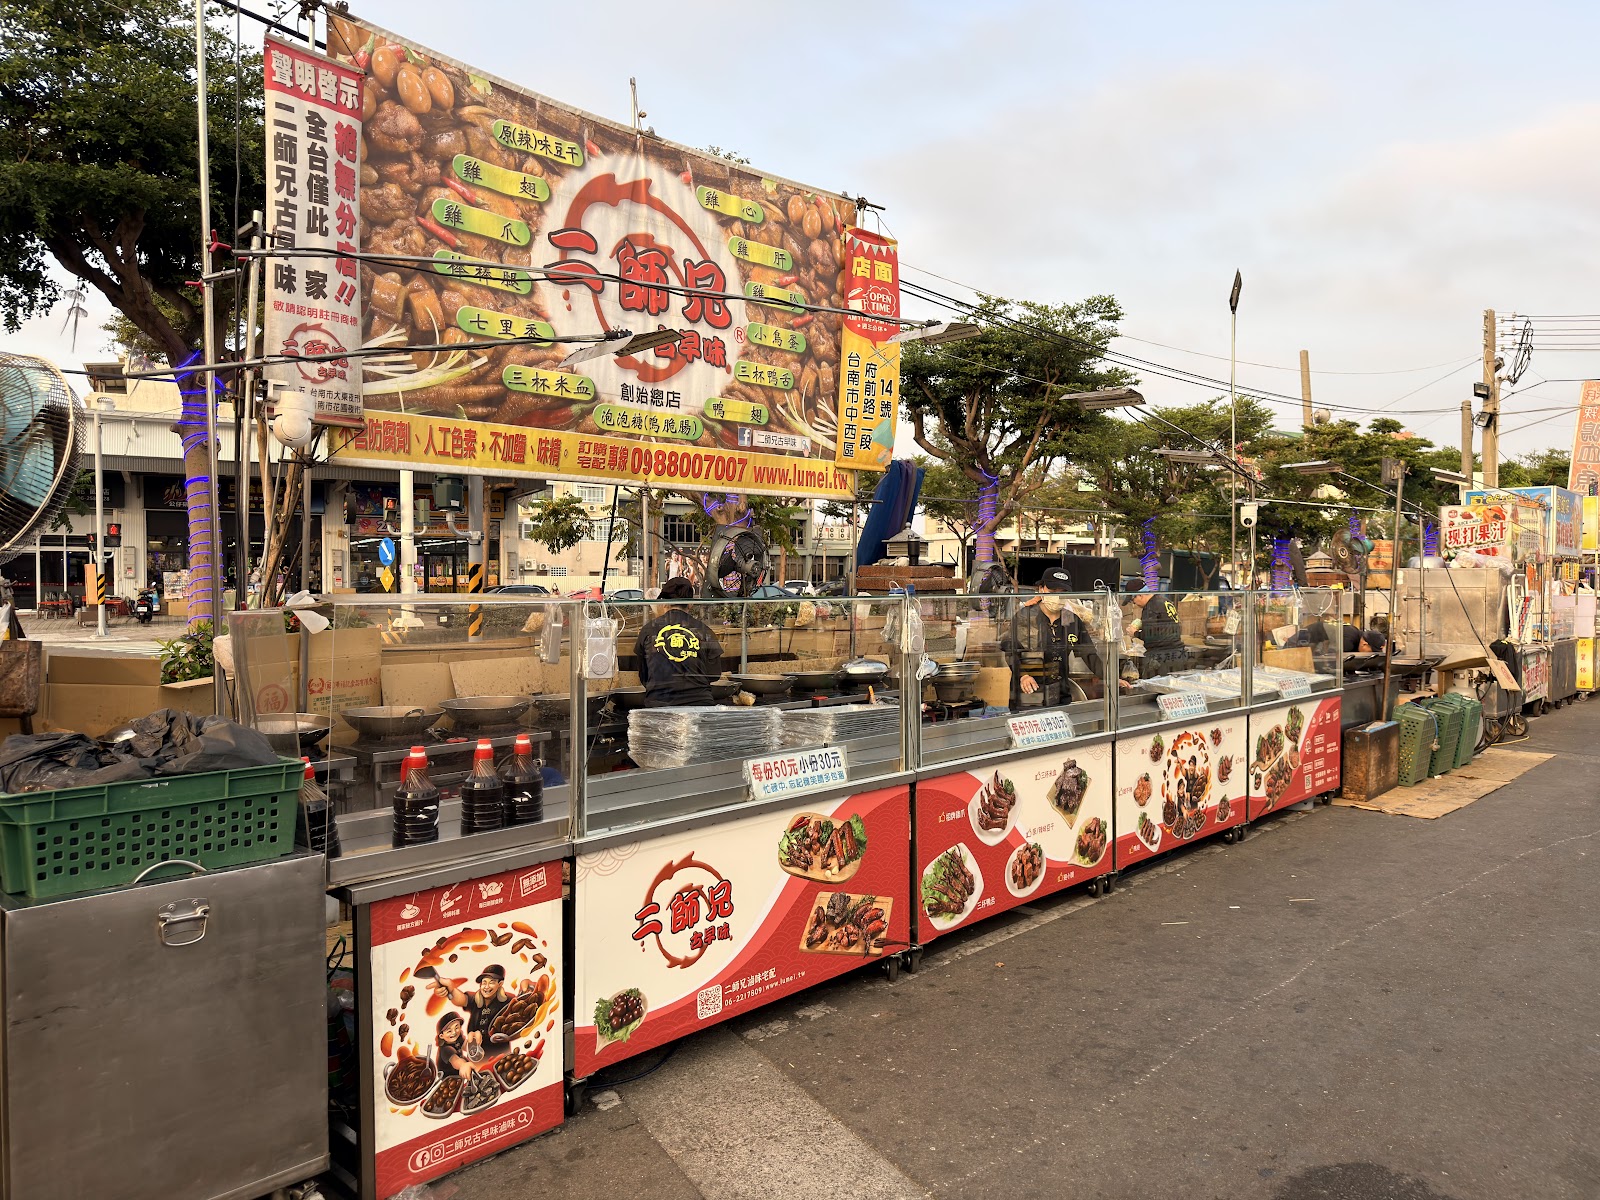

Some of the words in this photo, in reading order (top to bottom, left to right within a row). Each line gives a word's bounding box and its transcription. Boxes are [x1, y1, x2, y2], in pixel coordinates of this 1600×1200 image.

[498, 124, 580, 161] 原(辣)味豆干
[463, 160, 540, 199] 雞翅
[305, 109, 329, 300] 全台僅此家
[705, 190, 757, 218] 雞心
[443, 203, 520, 242] 雞爪
[737, 239, 787, 269] 雞肝
[543, 227, 732, 329] 二師兄
[852, 256, 893, 283] 店面
[870, 292, 892, 304] OPEN
[871, 302, 891, 314] TIME
[469, 314, 544, 339] 七里香
[507, 371, 592, 397] 三杯米血
[737, 365, 792, 387] 三杯鴨舌
[620, 383, 681, 409] 創始總店
[843, 351, 861, 458] 台南市中西區
[859, 362, 878, 451] 府前路二段
[880, 379, 893, 419] 14號
[712, 400, 763, 424] 鴨翅
[756, 434, 798, 448] 二師兄古早味
[630, 446, 748, 482] 0988007007
[753, 462, 848, 491] www.lumei.tw
[752, 758, 799, 782] 每份50元
[799, 751, 842, 774] 小份30元
[632, 879, 734, 941] 二師兄
[690, 922, 730, 950] 古早味
[724, 967, 777, 995] 二師兄滷味宅配
[445, 1118, 516, 1155] 二師兄古早味滷味
